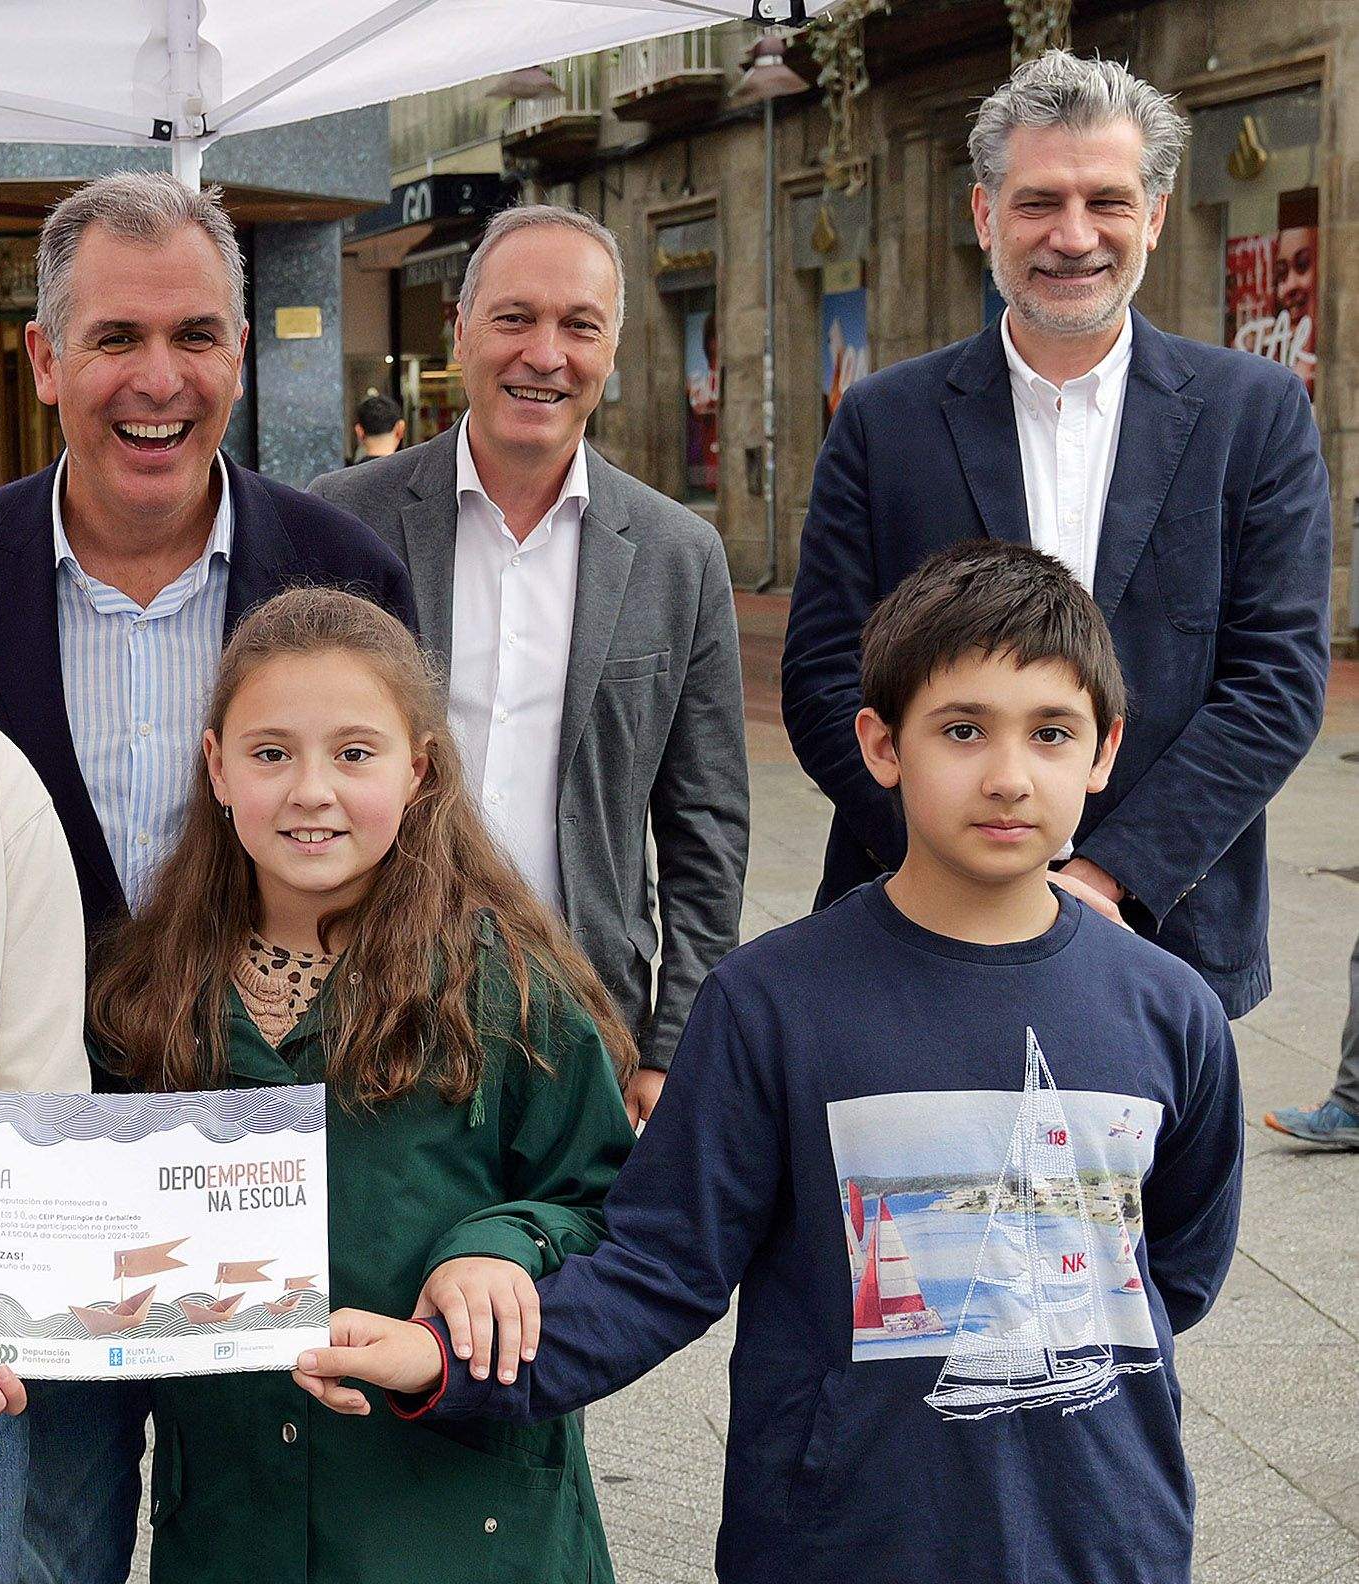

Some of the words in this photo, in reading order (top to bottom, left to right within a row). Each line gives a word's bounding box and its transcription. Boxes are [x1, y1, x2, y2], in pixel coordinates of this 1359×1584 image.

[1046, 1129, 1068, 1146] 118
[158, 1158, 307, 1191] DEPOEMPRENDE
[54, 1198, 101, 1207] Pontevedra
[208, 1190, 232, 1213] NA
[239, 1185, 307, 1211] ESCOLA
[38, 1213, 55, 1221] CEIP
[7, 1230, 39, 1238] ESCOLA
[52, 1232, 106, 1240] convocatoria
[1061, 1252, 1088, 1275] NK
[22, 1347, 71, 1357] Deputación
[125, 1347, 157, 1356] XUNTA
[216, 1345, 231, 1356] FP
[22, 1356, 71, 1364] Pontevedra
[125, 1356, 137, 1365] DE
[139, 1354, 176, 1364] GALICIA
